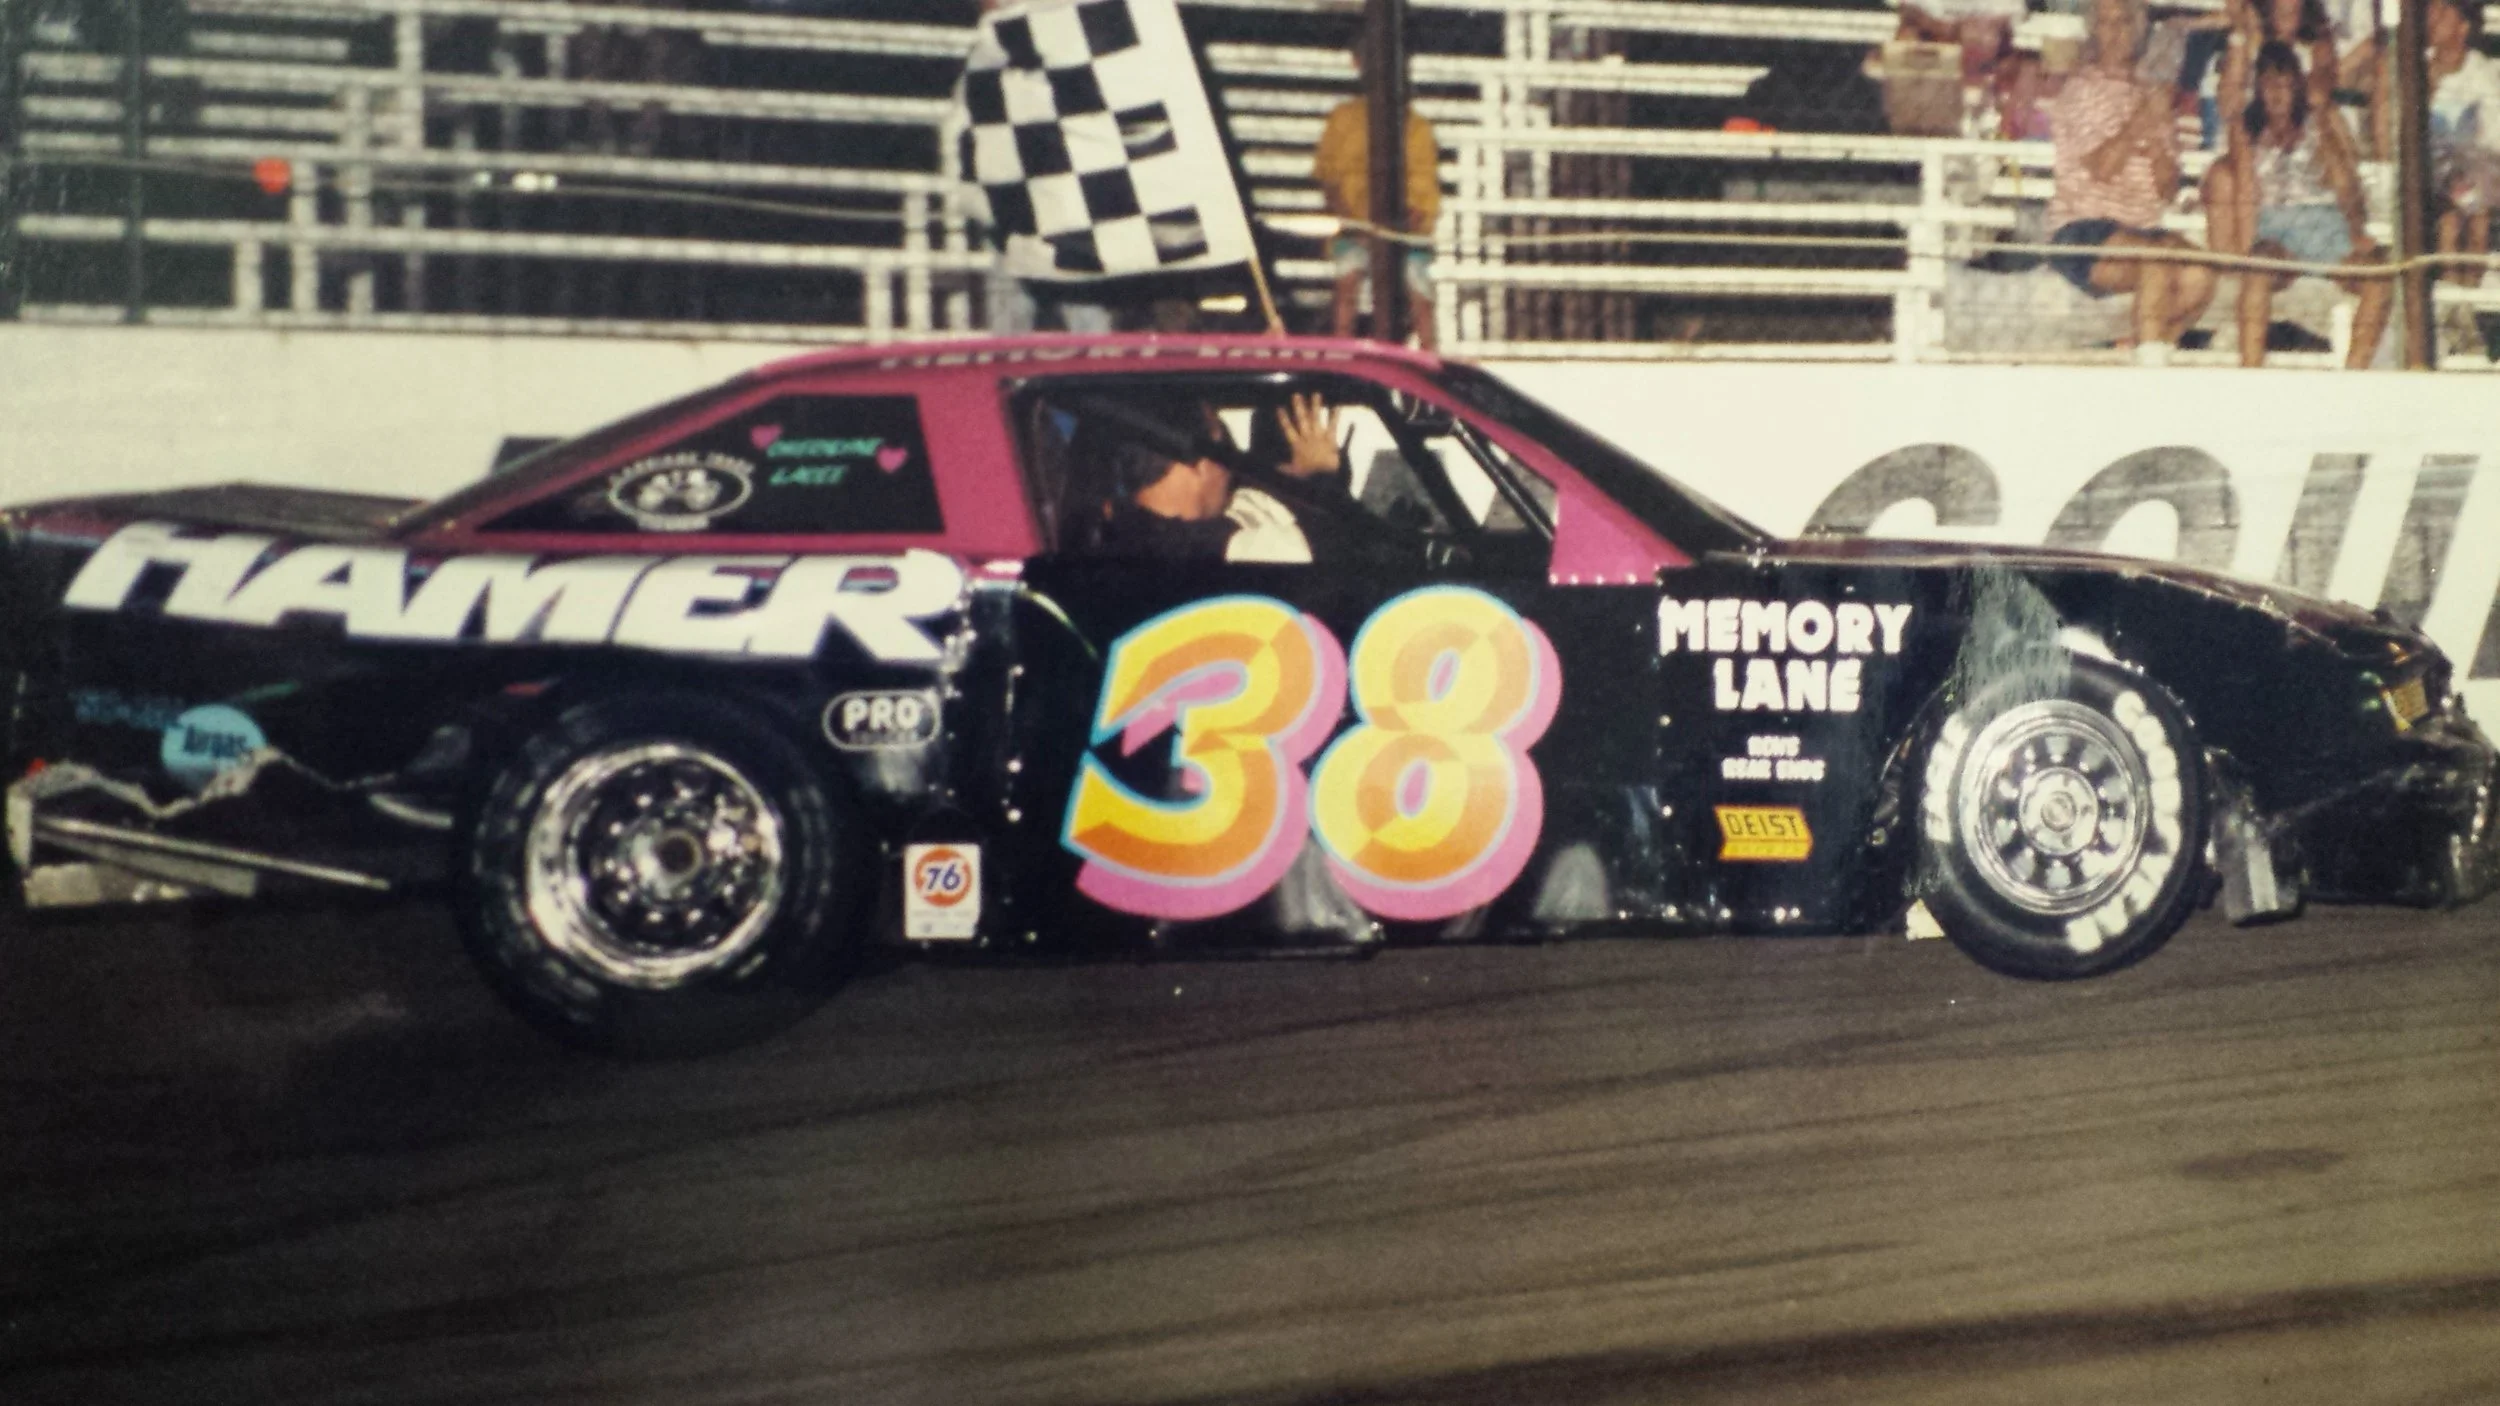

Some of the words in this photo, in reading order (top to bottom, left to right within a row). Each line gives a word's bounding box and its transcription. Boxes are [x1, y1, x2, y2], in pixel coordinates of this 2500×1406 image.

[62, 519, 965, 662] HAMER
[1657, 597, 1914, 656] MEMORY
[1713, 657, 1862, 713] LANE
[843, 697, 921, 731] PRO
[1060, 584, 1564, 922] 38
[1725, 812, 1800, 837] DEIST
[926, 863, 962, 892] 76
